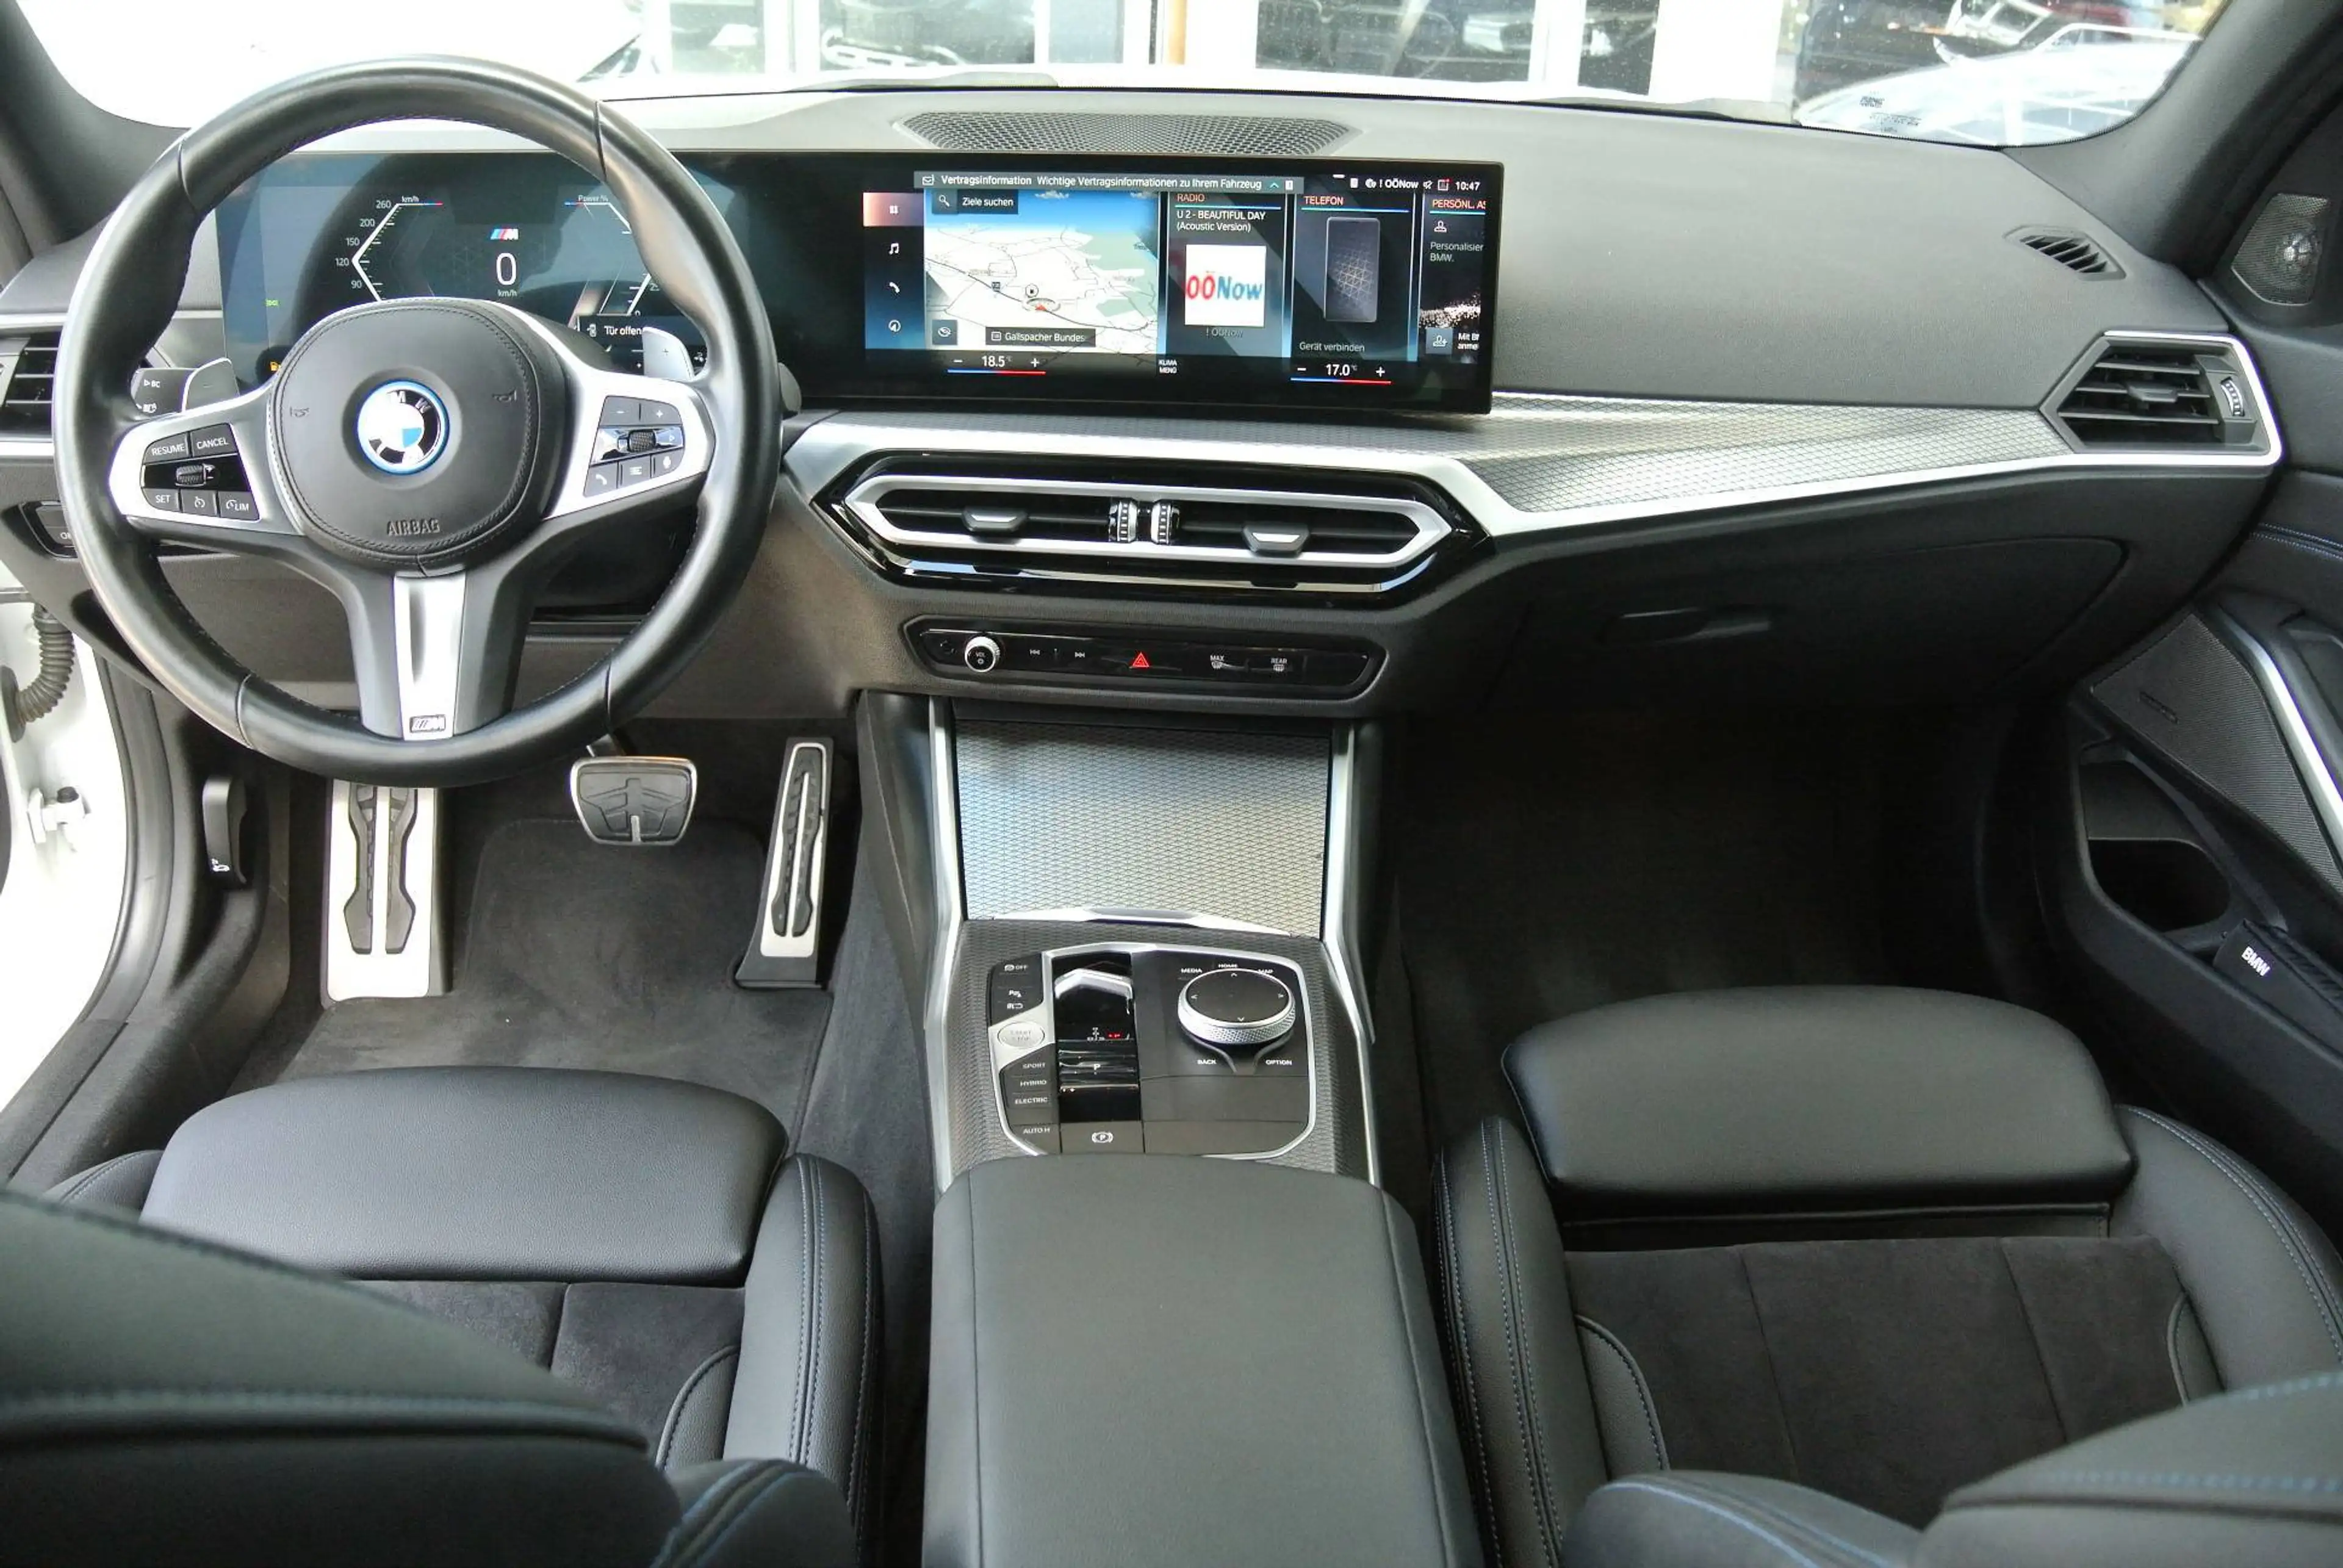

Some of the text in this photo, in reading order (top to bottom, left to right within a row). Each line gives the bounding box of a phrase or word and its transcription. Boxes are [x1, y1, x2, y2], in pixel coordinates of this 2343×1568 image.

[941, 175, 1032, 185] Vertragsinformation
[1037, 176, 1076, 187] Wichtige
[1078, 176, 1178, 188] Vertragsinformationen
[1192, 179, 1218, 189] Ihrem
[1220, 179, 1262, 190] Fahrzeug
[1455, 181, 1480, 191] 10:47
[962, 197, 1014, 207] Ziele suchen
[1176, 193, 1205, 203] RADIO
[1304, 196, 1344, 206] TELEFON
[1432, 197, 1475, 209] PERSÖNL.
[375, 200, 391, 209] 260
[1176, 210, 1183, 219] U
[1198, 211, 1246, 220] BEAUTIFUL
[1247, 212, 1266, 220] DAY
[359, 218, 375, 228] 200
[1176, 221, 1251, 232] (Acoustic Version)
[345, 237, 360, 246] 150
[1430, 242, 1484, 251] Personalisier
[335, 257, 350, 267] 120
[1430, 253, 1455, 262] BMW.
[496, 252, 517, 286] 0
[351, 280, 362, 289] 90
[1187, 271, 1262, 300] OÖNow
[497, 289, 517, 298] km/h
[603, 325, 642, 335] Tür offen
[1004, 332, 1053, 343] Gallspacher
[1299, 341, 1365, 353] Gerät verbinden
[196, 436, 229, 450] CANCEL
[151, 443, 185, 456] RESUME
[155, 494, 171, 504] SET
[234, 502, 250, 511] LIM
[386, 517, 441, 537] AIRBAG
[2241, 946, 2270, 976] BMW
